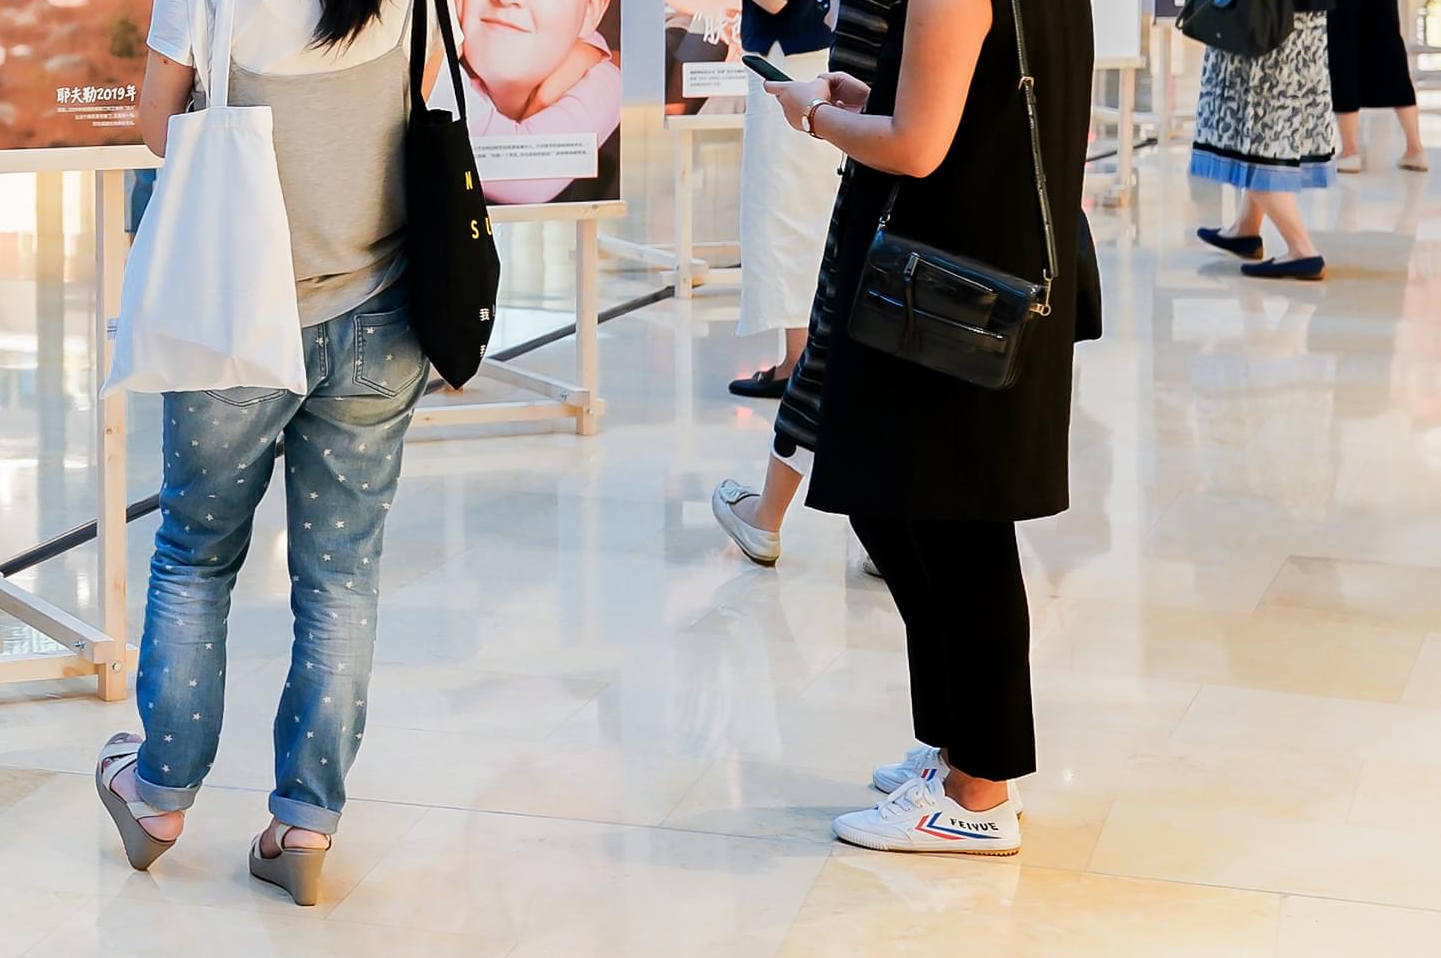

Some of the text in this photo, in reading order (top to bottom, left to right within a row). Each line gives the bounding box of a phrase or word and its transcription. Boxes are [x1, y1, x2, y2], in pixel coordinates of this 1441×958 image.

[56, 84, 136, 104] 耶夫勒2019年
[465, 170, 473, 191] N
[950, 818, 999, 831] FEIYUE
